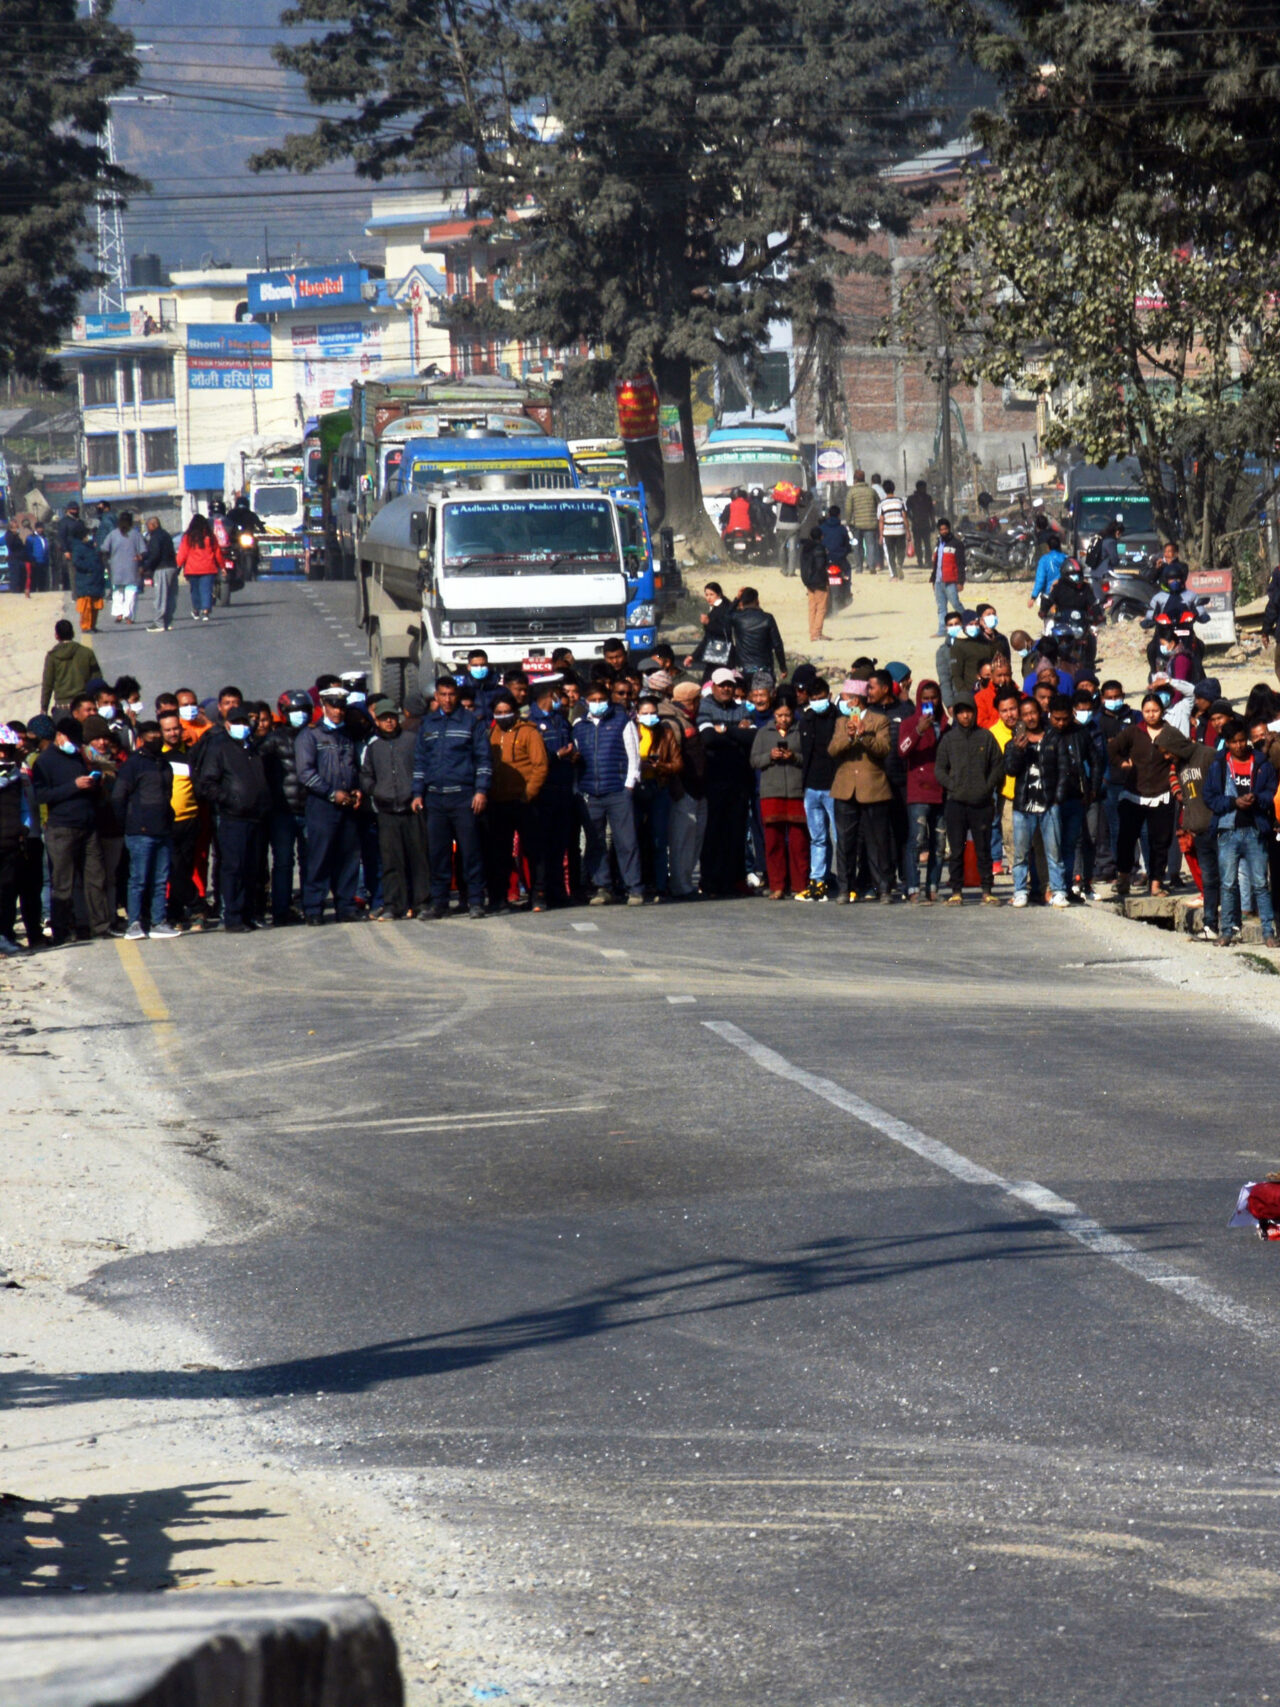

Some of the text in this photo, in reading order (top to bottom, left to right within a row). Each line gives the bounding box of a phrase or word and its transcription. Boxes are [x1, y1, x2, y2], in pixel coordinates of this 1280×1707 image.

[299, 275, 344, 298] Hospital
[502, 503, 526, 512] Dairy
[528, 502, 557, 511] Product
[581, 502, 597, 511] Ltd.
